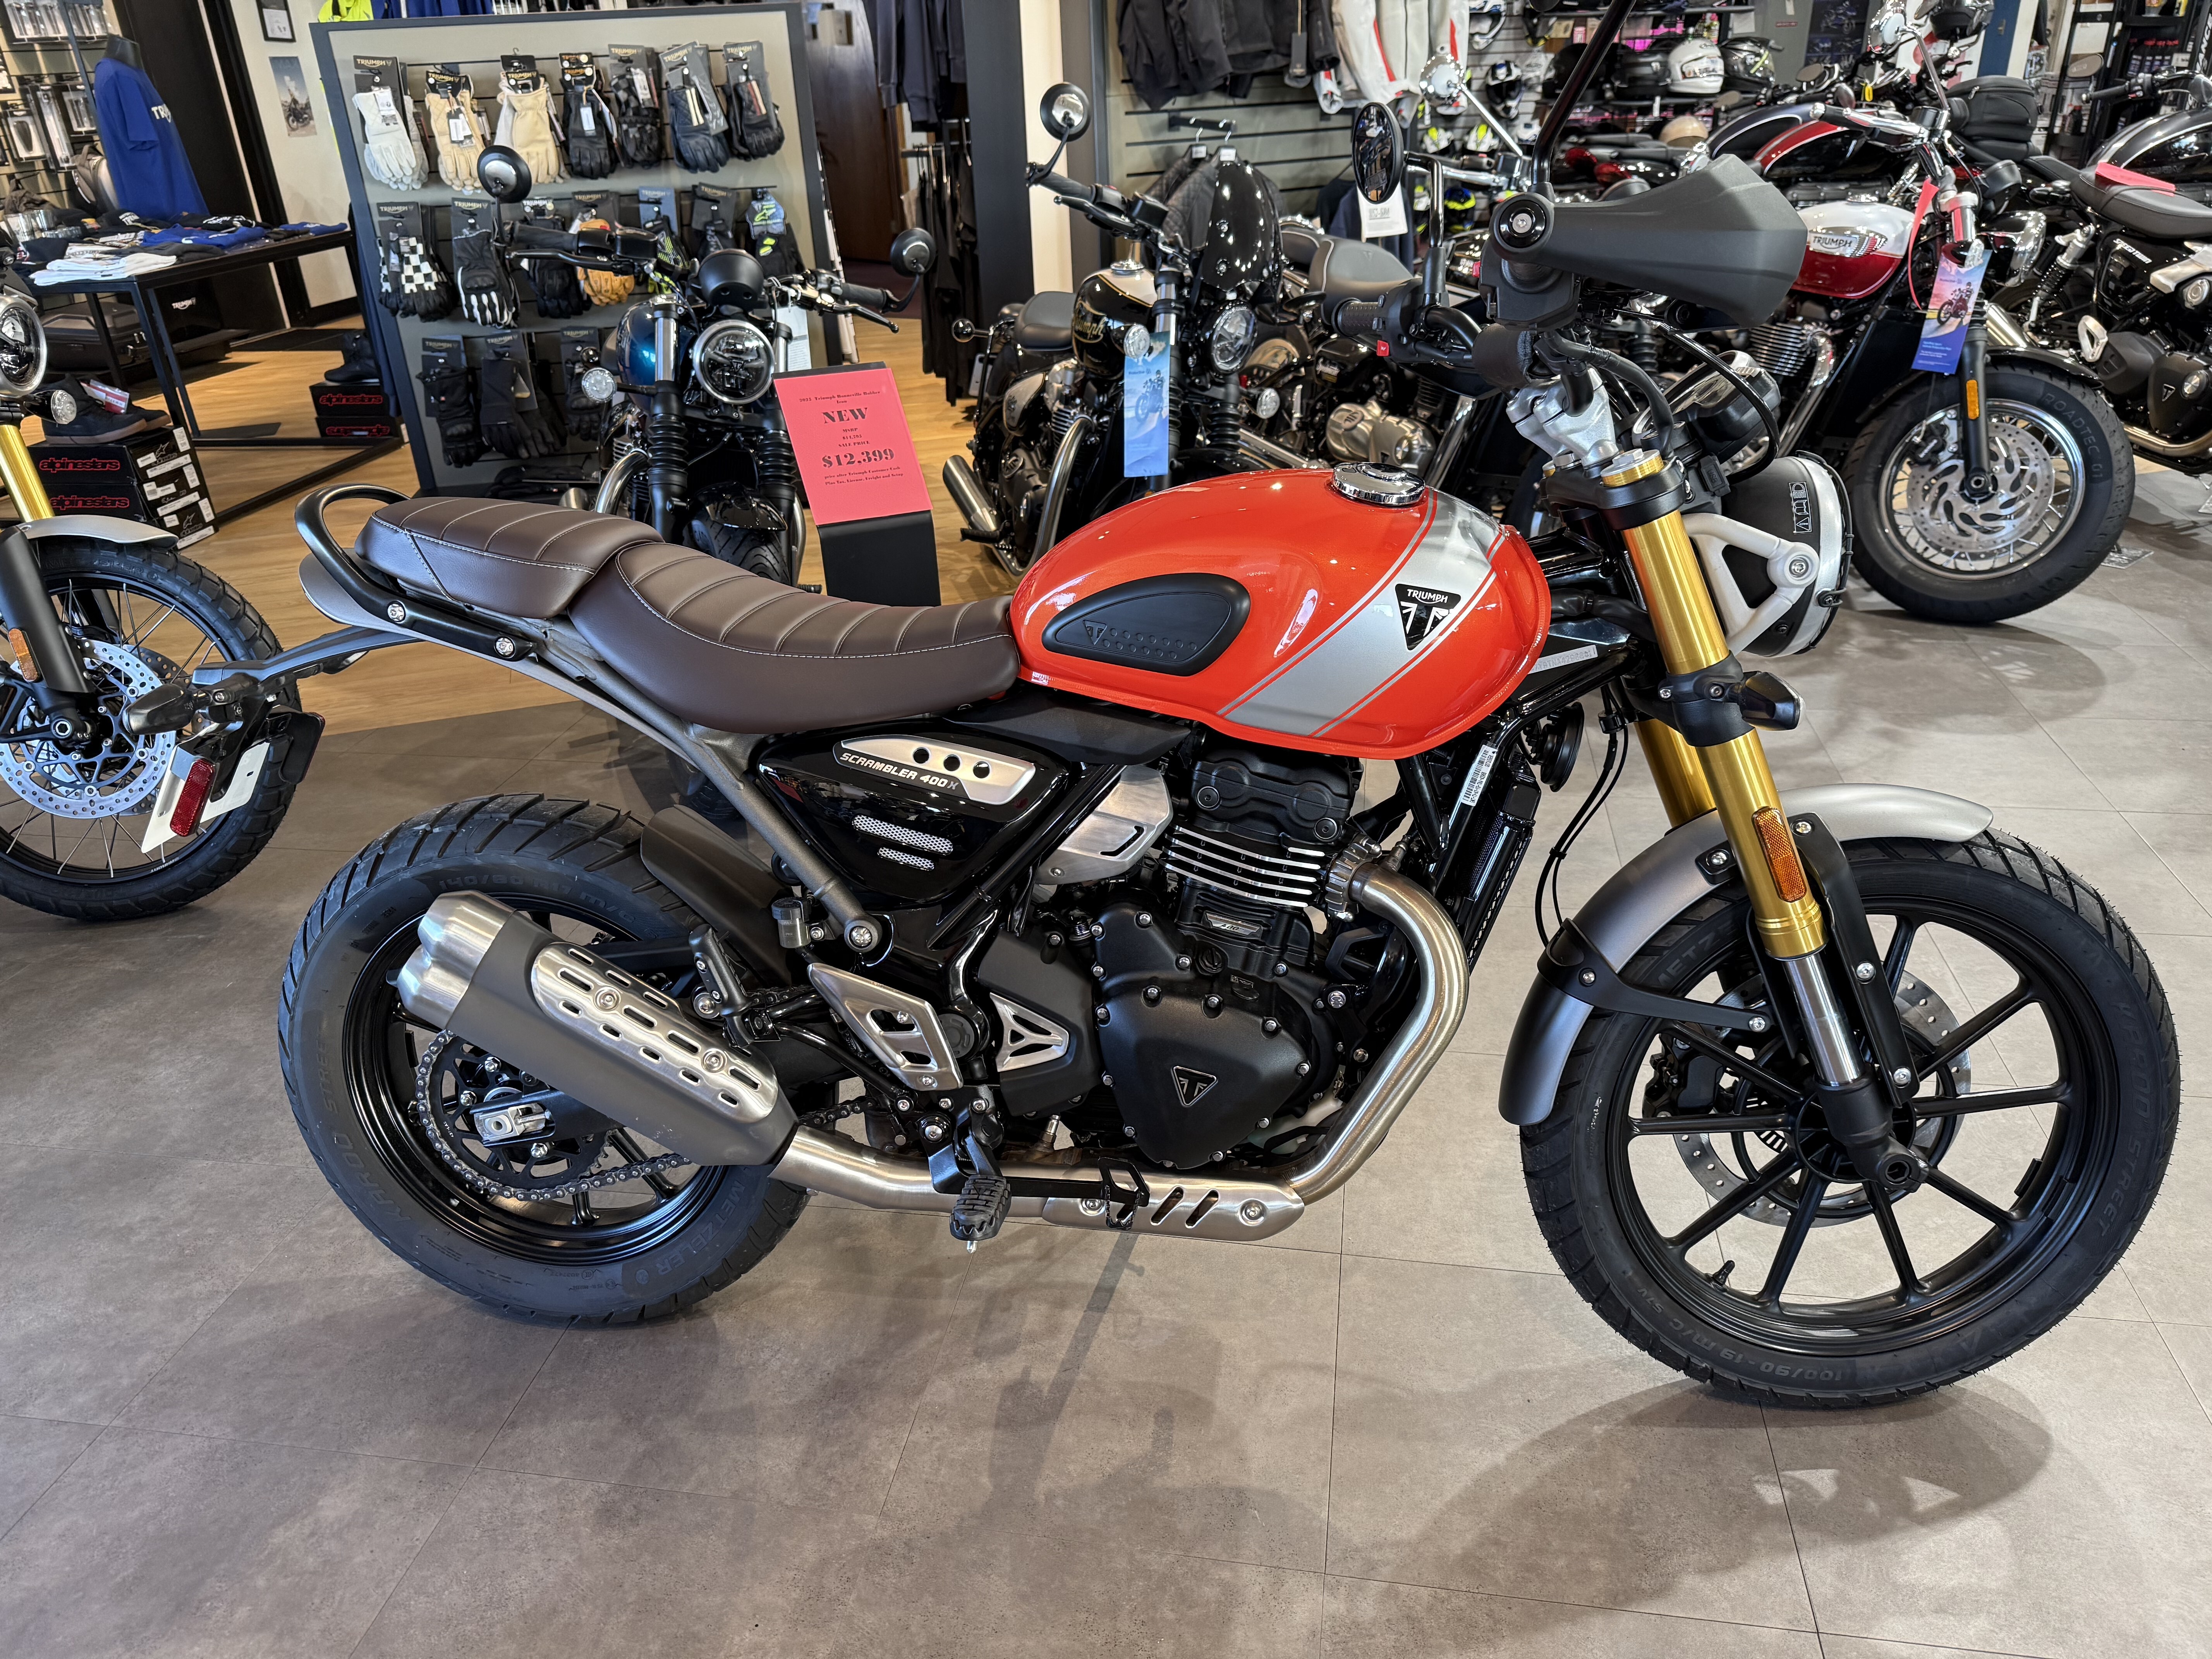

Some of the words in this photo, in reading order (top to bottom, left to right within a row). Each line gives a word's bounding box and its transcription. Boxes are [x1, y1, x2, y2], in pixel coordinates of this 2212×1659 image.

[356, 58, 386, 67] TRIUMPH
[428, 73, 453, 82] TRIUMPH
[453, 201, 482, 210] TRIUMPH
[1813, 236, 1853, 249] TRIUMPH
[821, 407, 867, 424] NEW
[2041, 393, 2101, 455] ROADTEC
[39, 457, 120, 473] alpinestars
[822, 448, 894, 469] $12,399
[1707, 469, 1718, 485] USB
[49, 495, 130, 510] alpinestars
[1407, 589, 1448, 604] TRIUMPH
[840, 752, 918, 780] SCRAMBLER
[439, 874, 524, 891] 140/80
[2099, 1140, 2142, 1237] STREET
[657, 1180, 747, 1276] METZELER
[1669, 1318, 1716, 1351] M/C
[1760, 1362, 1843, 1381] 100/90
